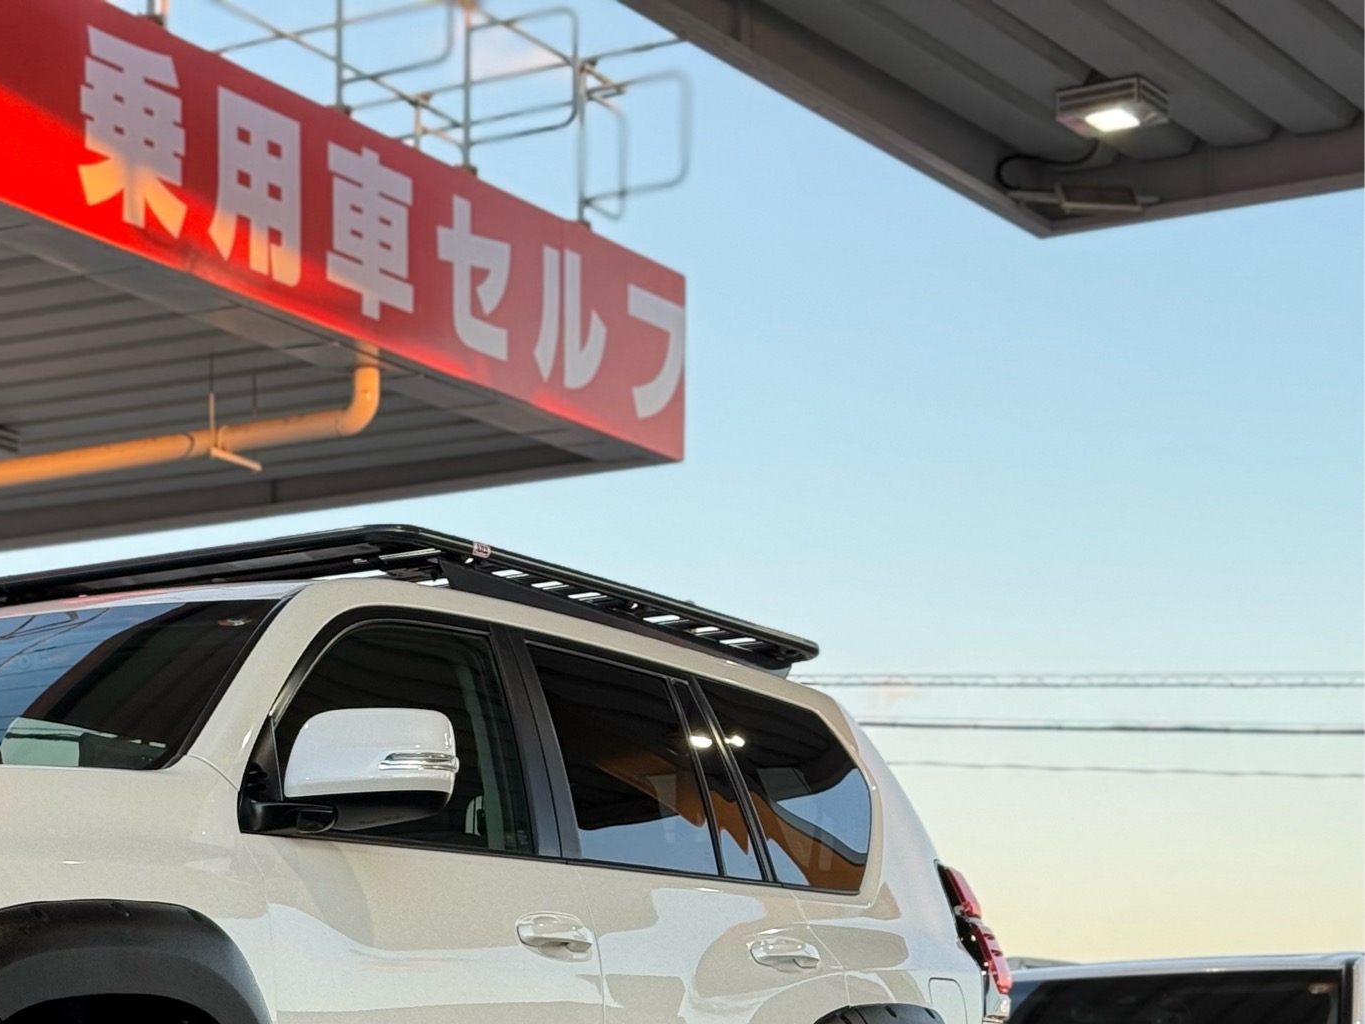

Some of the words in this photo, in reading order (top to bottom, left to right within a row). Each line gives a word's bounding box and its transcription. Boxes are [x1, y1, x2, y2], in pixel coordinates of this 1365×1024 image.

[77, 25, 684, 420] 乗用車セルフ
